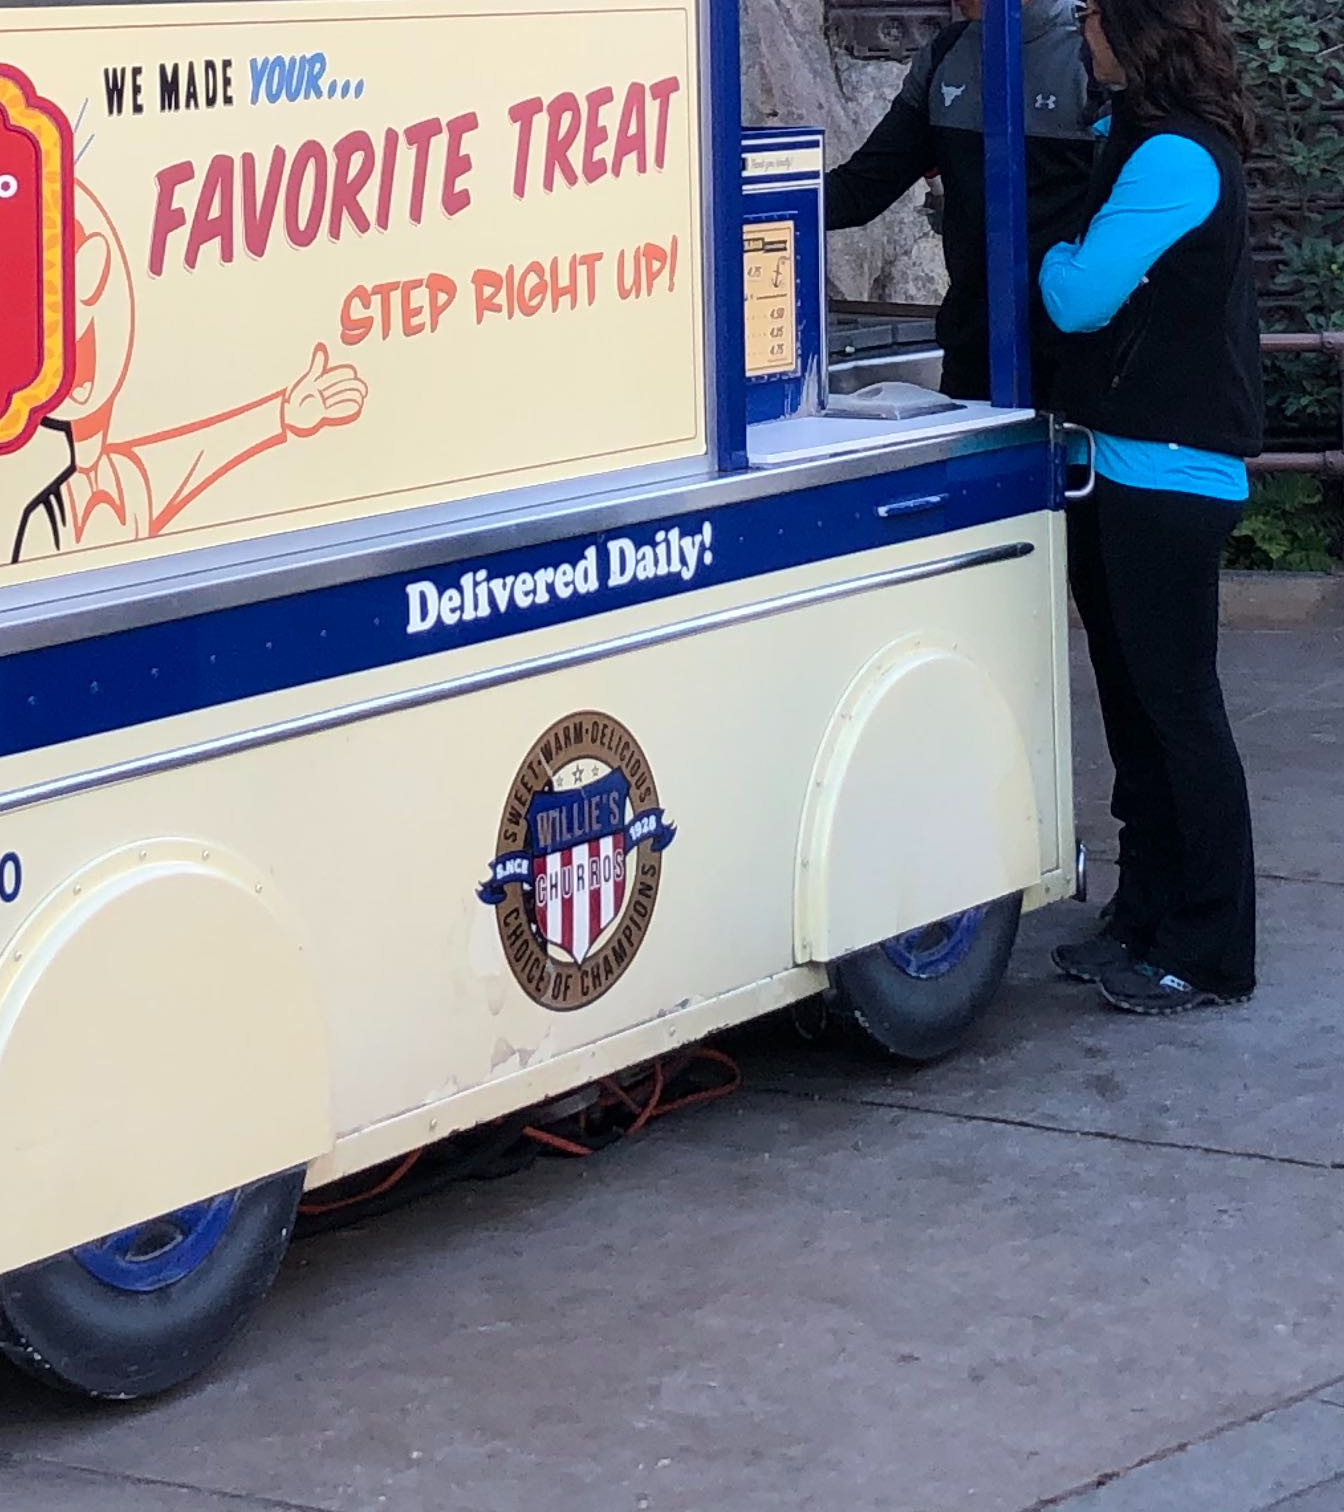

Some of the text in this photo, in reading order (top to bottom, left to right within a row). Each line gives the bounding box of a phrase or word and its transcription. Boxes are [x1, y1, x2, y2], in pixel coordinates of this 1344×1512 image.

[103, 65, 144, 117] WE
[159, 58, 235, 113] MADE
[148, 76, 680, 279] FAVORITE TREAT
[340, 234, 679, 346] STEP RIGHT UP!
[406, 522, 714, 636] Delivered Daily!
[536, 791, 620, 850] WILLIE'S
[629, 814, 657, 840] 1928
[535, 848, 624, 908] CHURROS
[504, 863, 656, 1002] CHOICE OF CHAMPIONS
